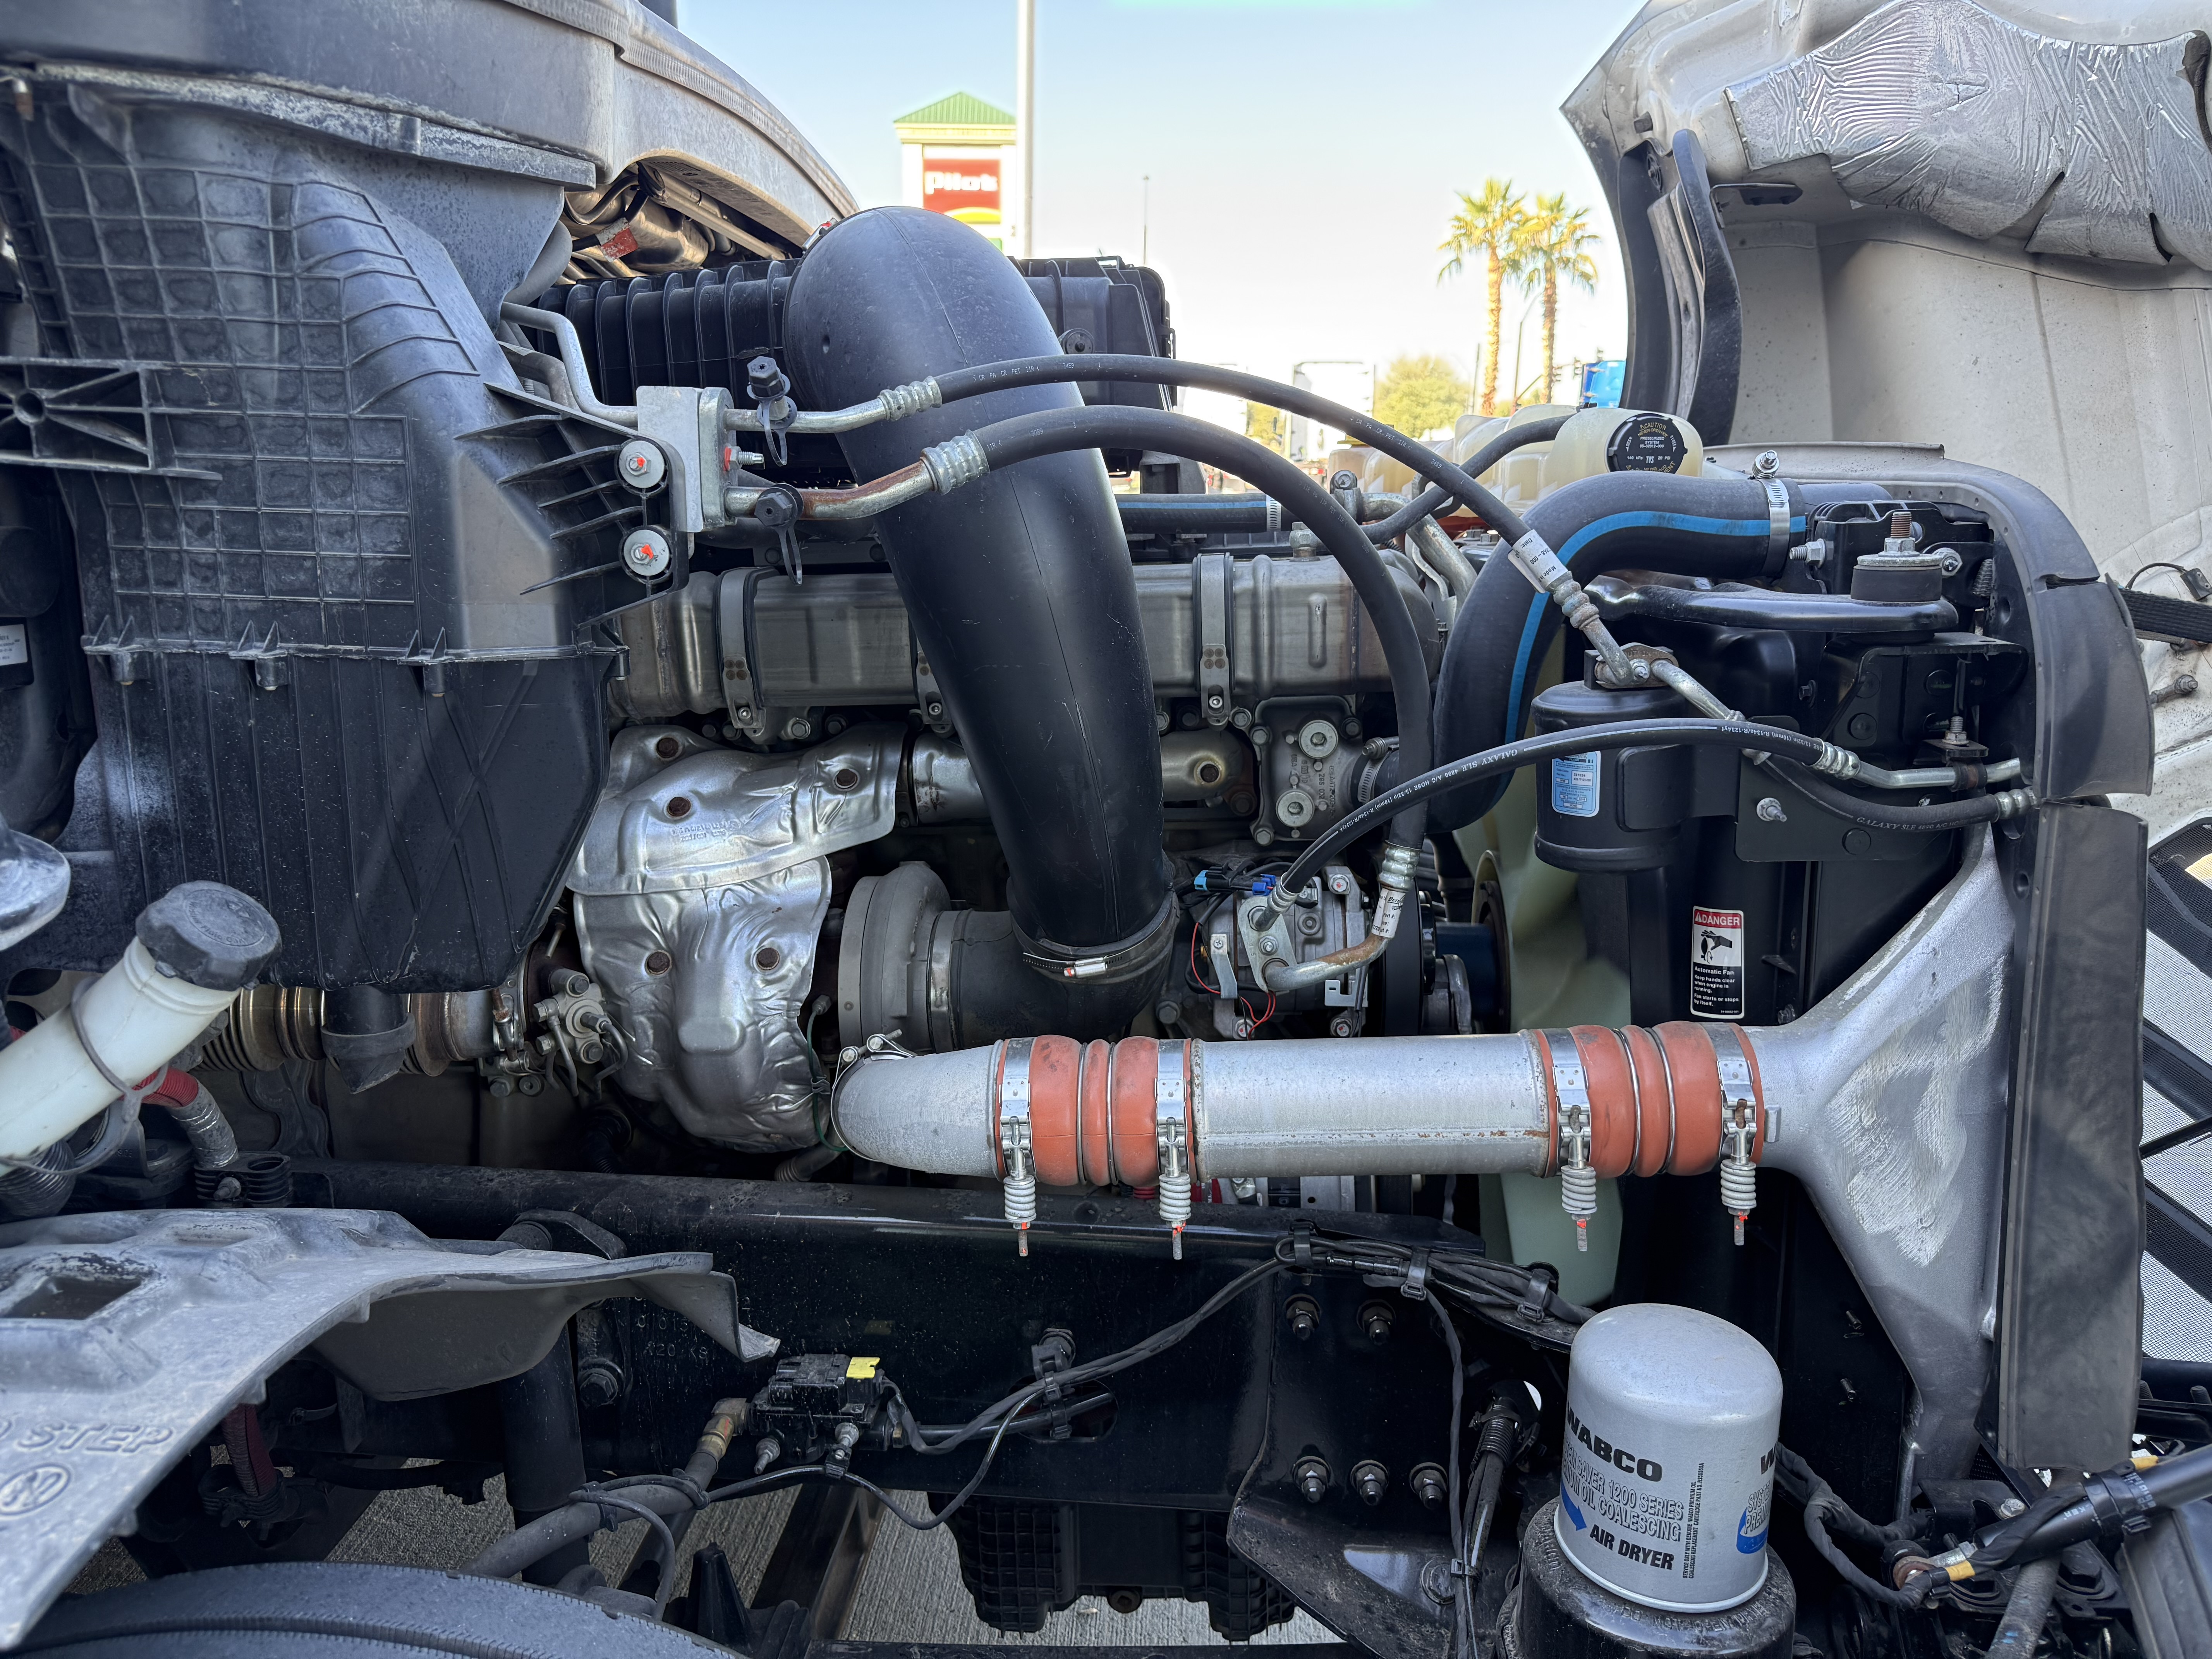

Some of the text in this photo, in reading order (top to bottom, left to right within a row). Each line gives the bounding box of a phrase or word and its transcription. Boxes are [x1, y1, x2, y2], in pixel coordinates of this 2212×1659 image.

[925, 172, 998, 194] Pilot
[1638, 428, 1650, 436] NEVER
[1543, 565, 1556, 576] Made
[1482, 749, 1518, 765] GALAXY
[1461, 761, 1477, 771] SLE
[1414, 780, 1429, 790] HOSE
[1432, 775, 1442, 783] A/C
[1856, 817, 1900, 829] GALAXY
[1702, 914, 1740, 926] DANGER
[1695, 966, 1721, 975] Automatic
[17, 1422, 174, 1452] STEP
[1567, 1400, 1662, 1482] WABCO
[1577, 1456, 1605, 1494] SAVER
[1609, 1479, 1636, 1509] 1200
[1640, 1493, 1684, 1521] SERIES
[1747, 1480, 1771, 1513] SYSTE
[1581, 1482, 1595, 1511] OIL
[1598, 1496, 1681, 1542] COALESCING
[1590, 1524, 1615, 1551] AIR
[1618, 1539, 1675, 1570] DRYER
